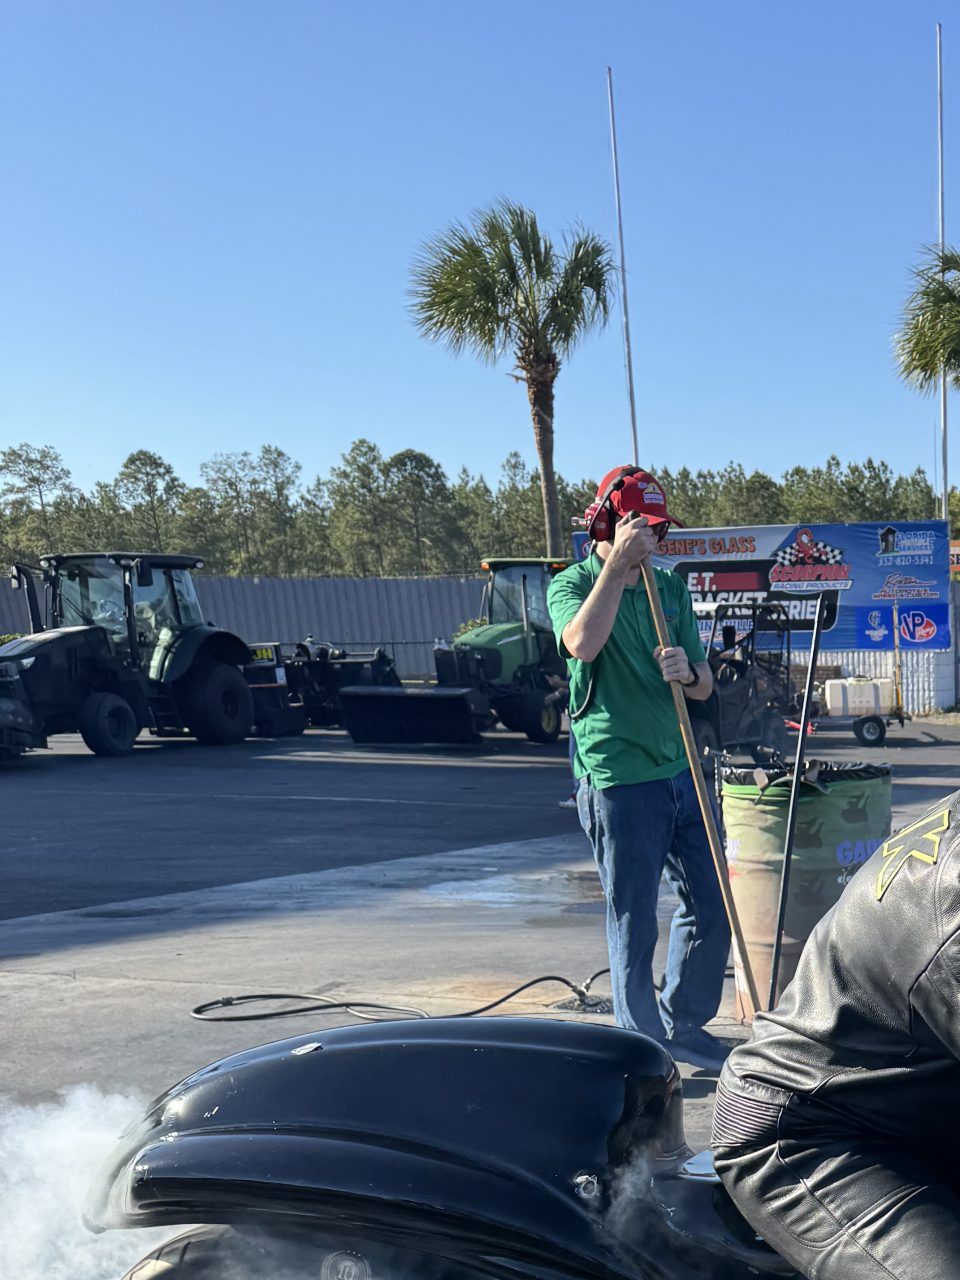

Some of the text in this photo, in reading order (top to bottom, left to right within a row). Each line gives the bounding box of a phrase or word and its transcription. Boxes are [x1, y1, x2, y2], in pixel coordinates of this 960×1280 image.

[709, 536, 756, 554] GLASS
[687, 572, 716, 591] E.T.
[771, 564, 850, 581] SCORPION
